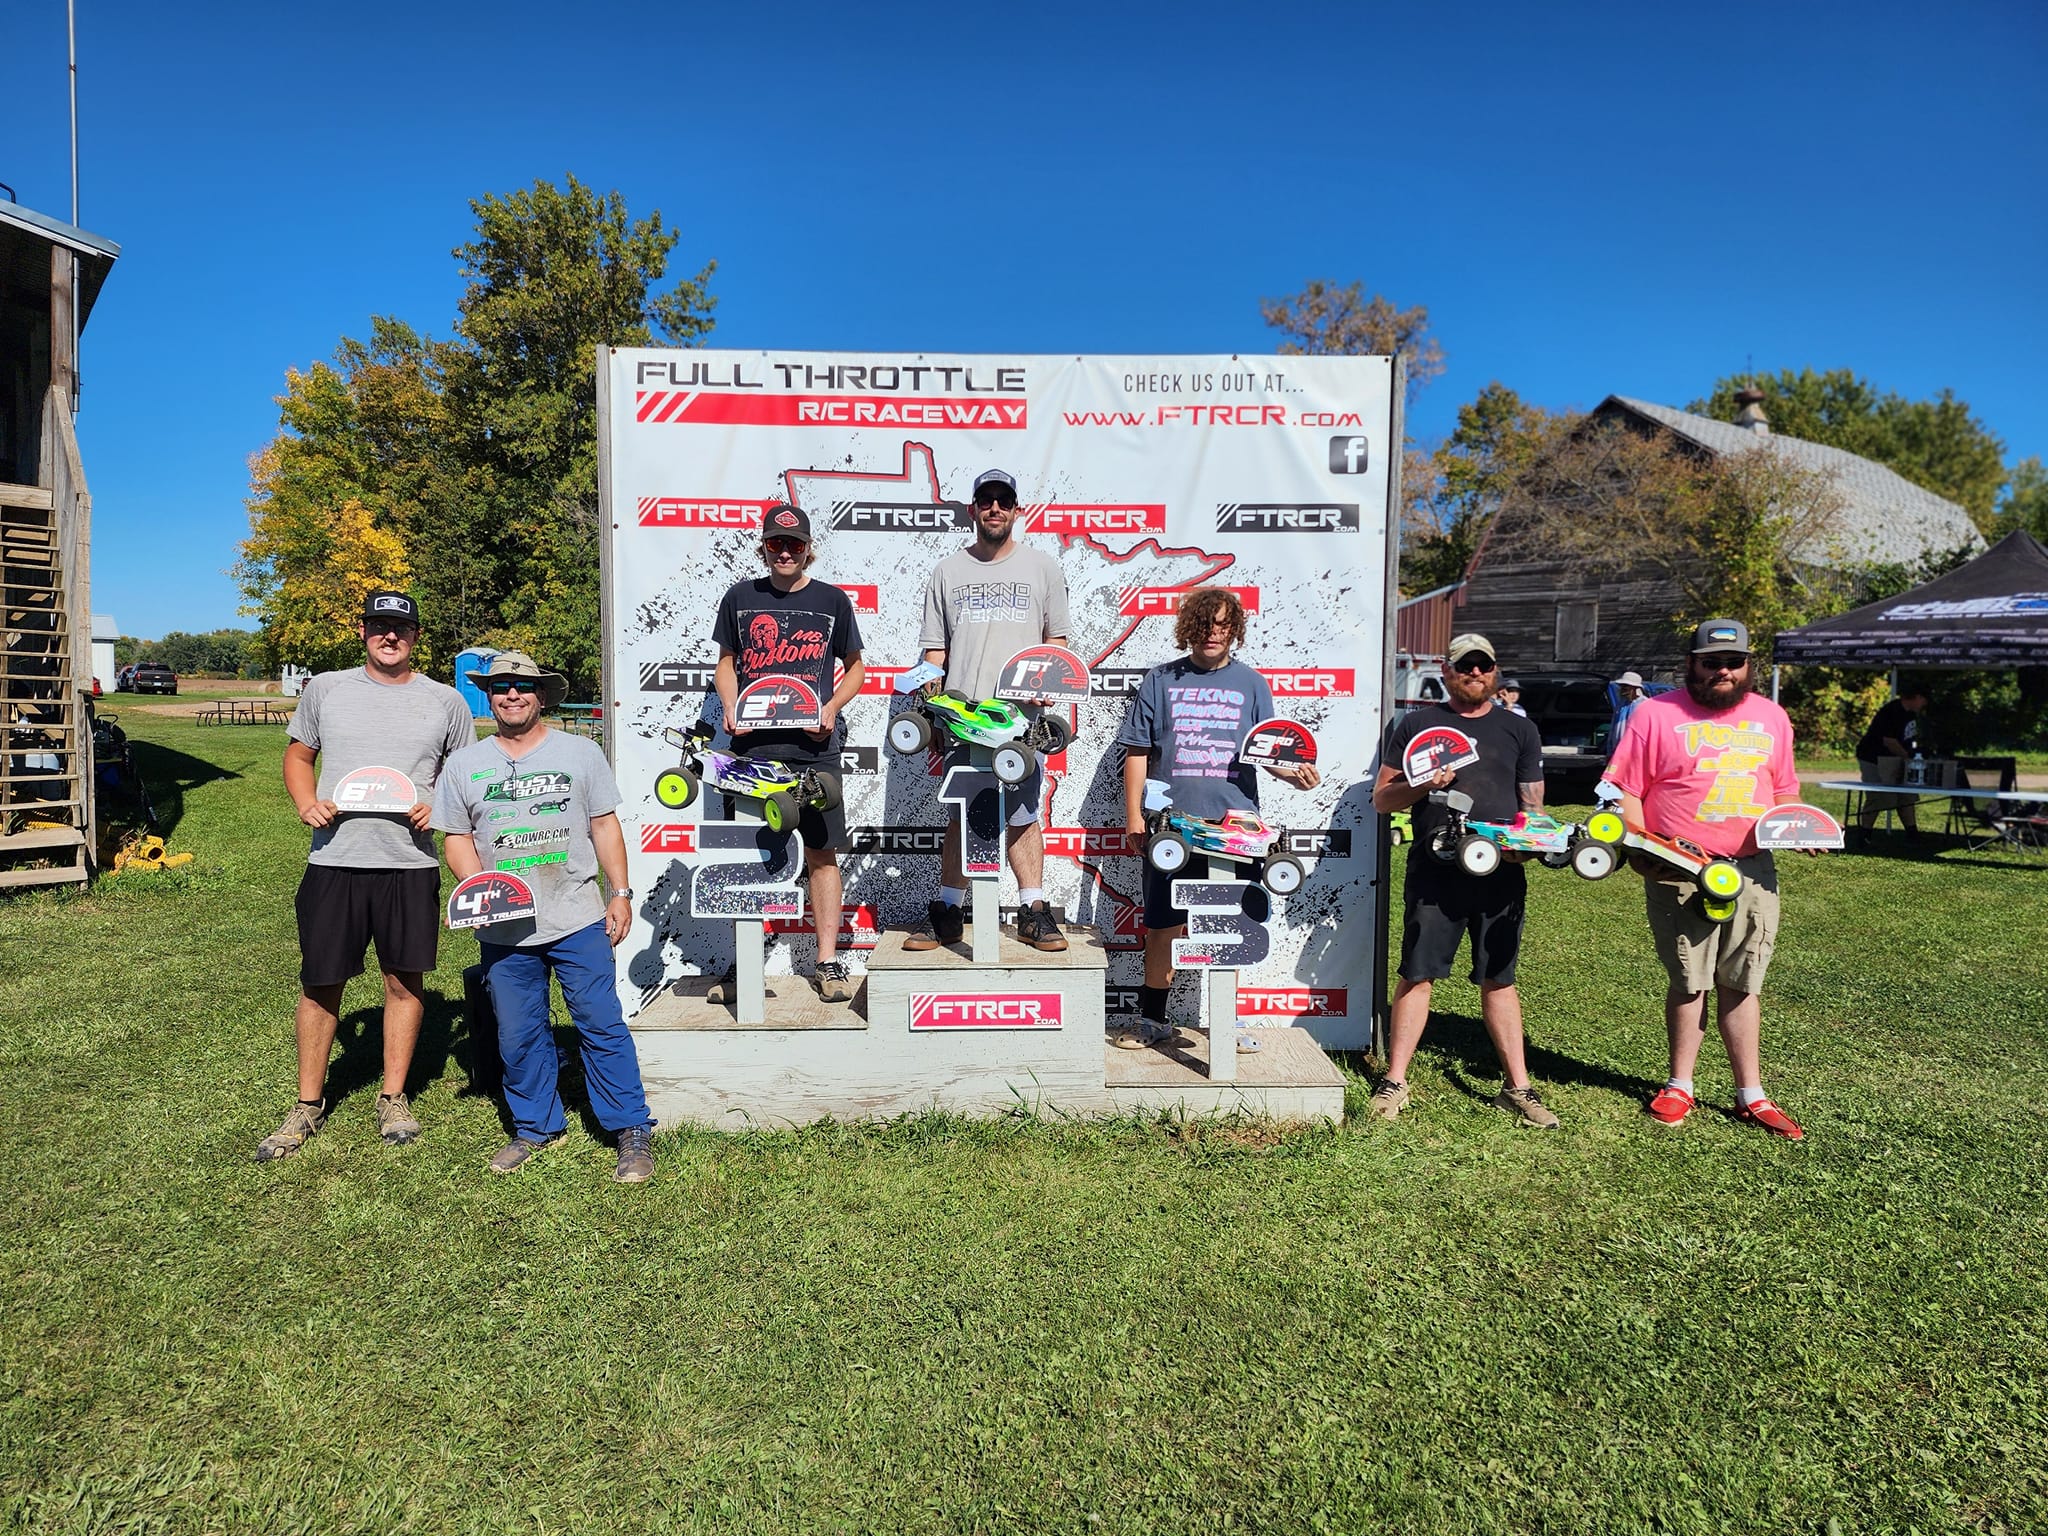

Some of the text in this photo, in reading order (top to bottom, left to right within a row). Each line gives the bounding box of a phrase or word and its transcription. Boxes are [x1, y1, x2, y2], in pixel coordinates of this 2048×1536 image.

[637, 361, 1026, 392] FULL THROTTLE
[1124, 374, 1305, 393] CHECK US OUT AT...
[798, 401, 1026, 425] R/C RACEWAY
[657, 503, 763, 523] FTRCR
[851, 508, 955, 527] FTRCR
[1043, 510, 1147, 528] FTRCR
[1235, 509, 1342, 528] FTRCR
[953, 582, 1031, 600] TEKNO
[954, 595, 1030, 610] TEKNO
[1011, 660, 1053, 687] 1ST
[999, 689, 1088, 701] NITRO TRUGGY
[1168, 687, 1245, 706] TEKNO
[742, 694, 790, 718] 2ND
[736, 718, 818, 727] NITRO TRUGGY
[1248, 733, 1294, 757] 3RD
[1243, 755, 1276, 765] NITRO
[515, 783, 571, 798] BODIES
[1765, 820, 1808, 839] 7TH
[457, 889, 501, 915] 4TH
[452, 907, 535, 926] NITRO TRUGGY
[933, 1000, 1041, 1020] FTRCR
